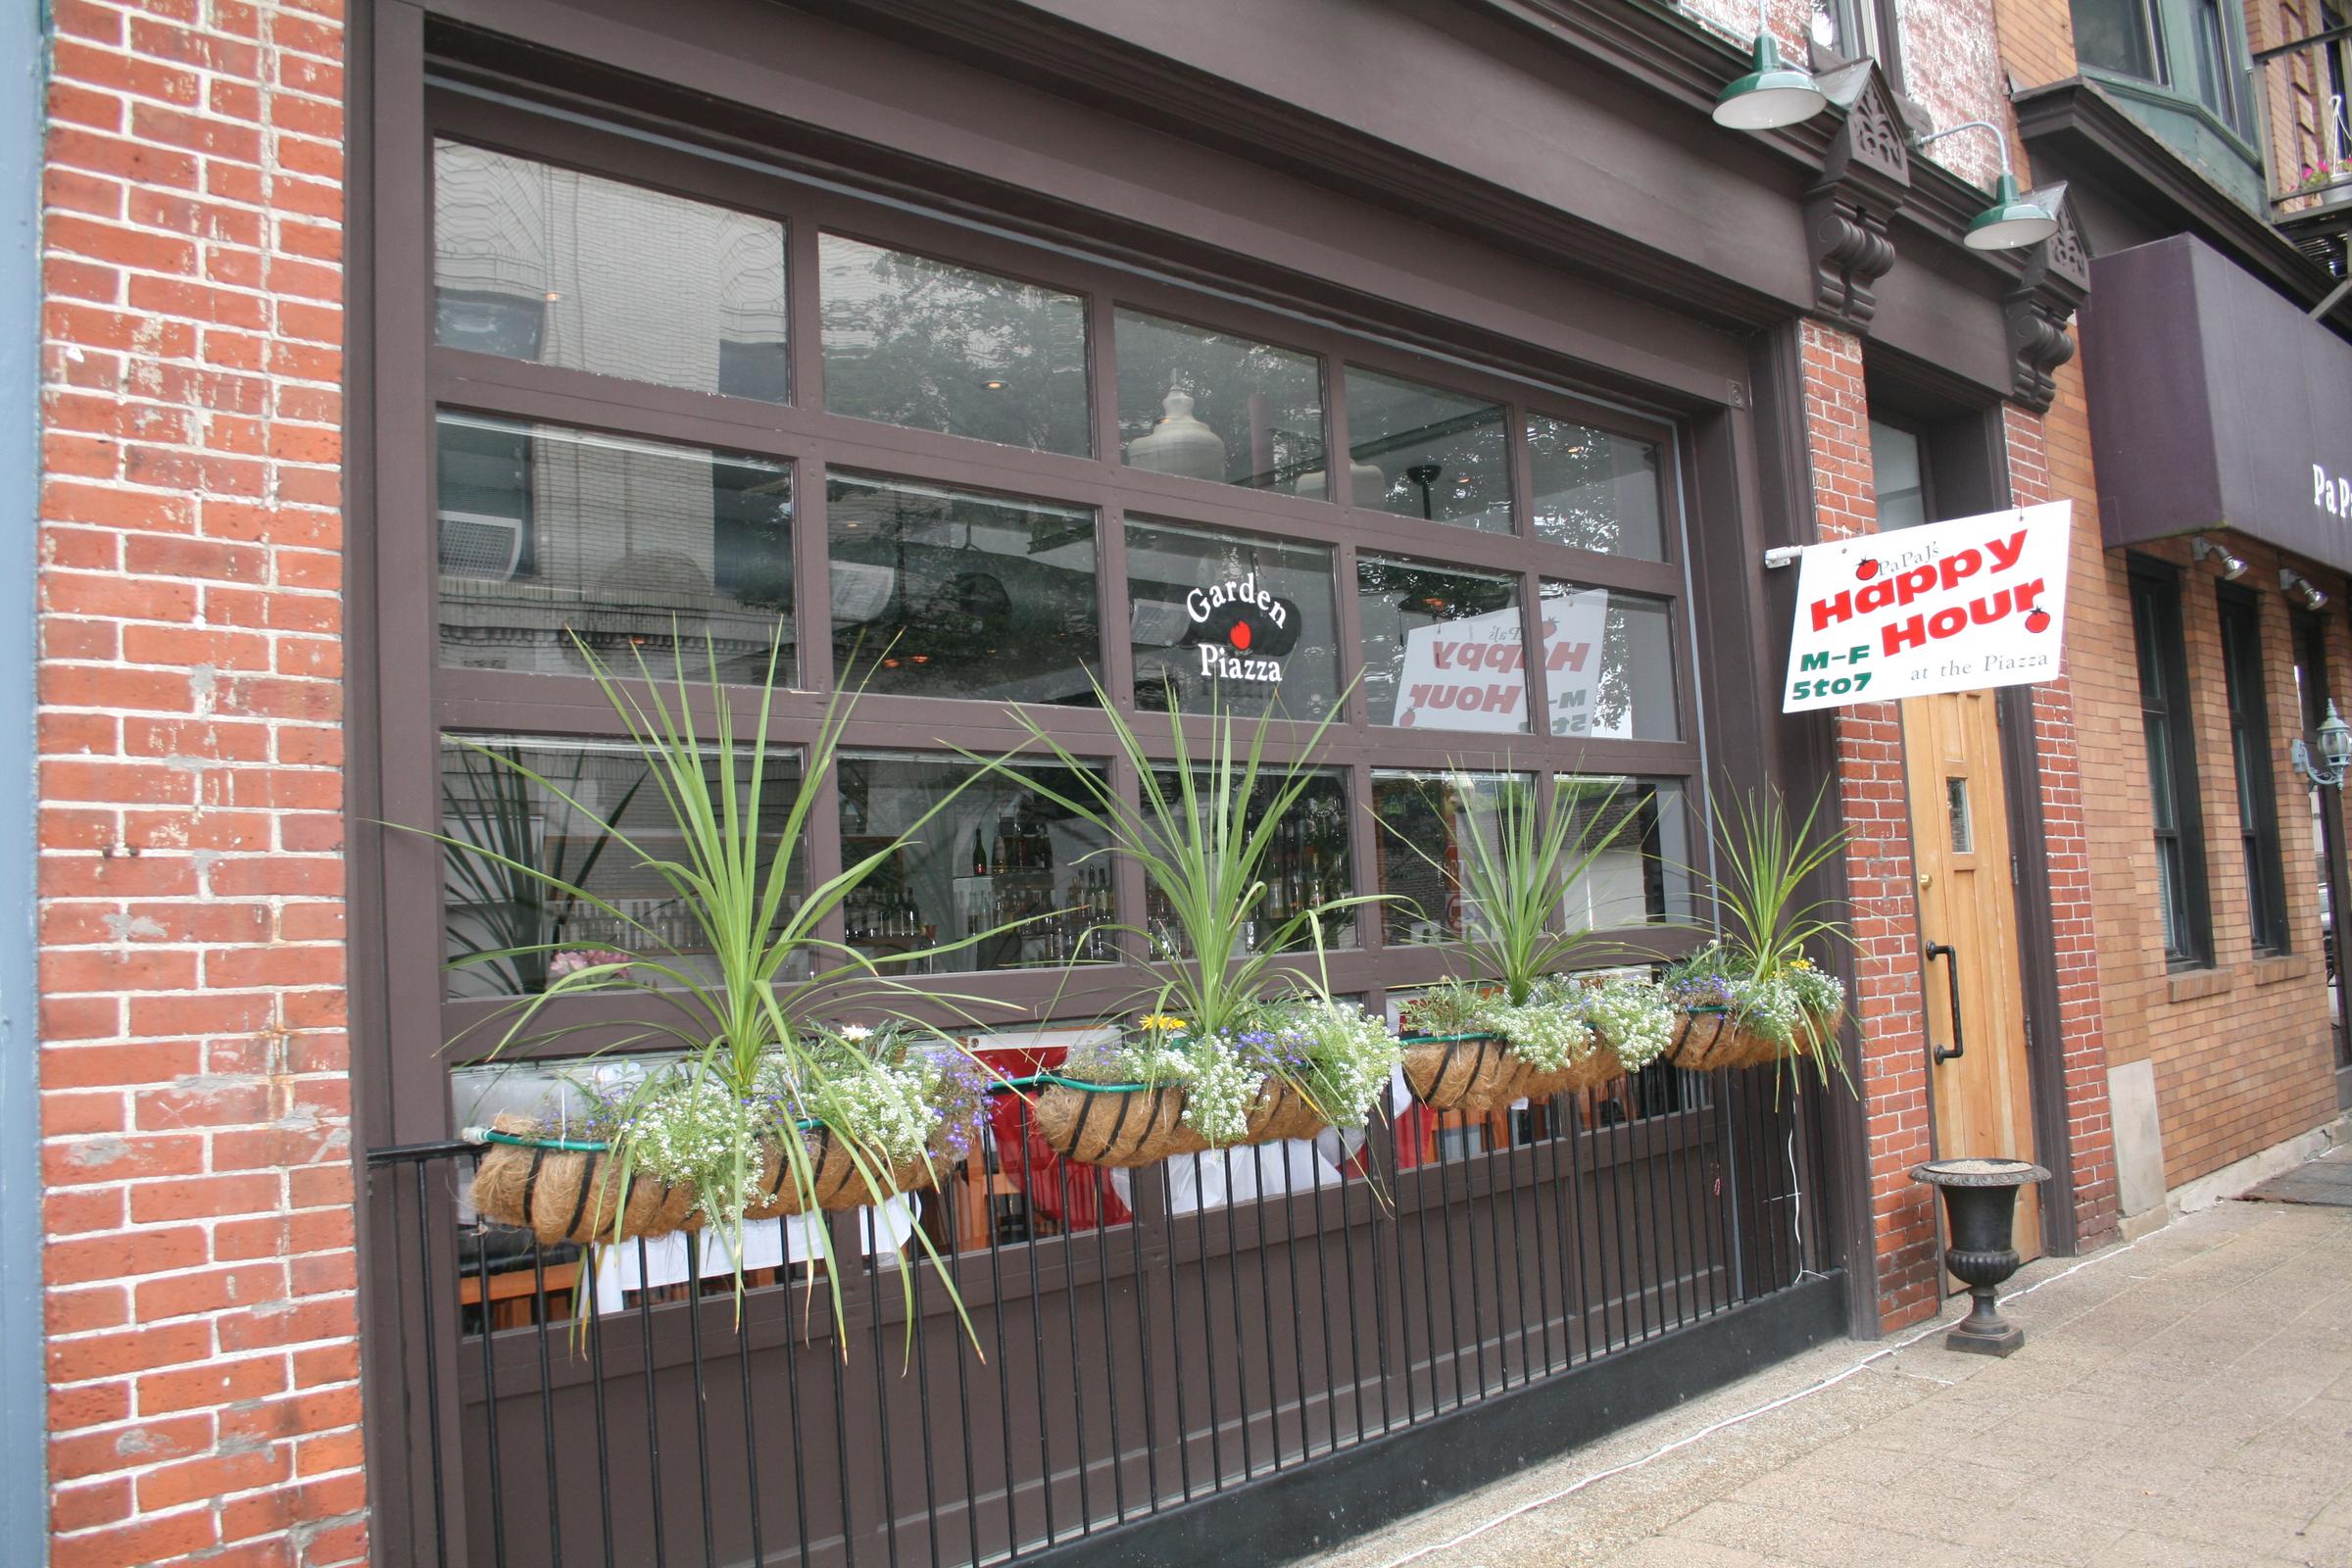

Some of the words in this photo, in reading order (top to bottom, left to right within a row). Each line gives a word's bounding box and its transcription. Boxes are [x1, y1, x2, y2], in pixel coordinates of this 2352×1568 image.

[2312, 463, 2352, 518] PaP
[1187, 572, 1287, 629] Garden
[1810, 528, 2028, 632] Happy
[1881, 577, 2045, 658] Hour
[1198, 643, 1283, 682] Piazza
[1800, 645, 1870, 672] M-F
[1910, 666, 1930, 681] at
[1940, 659, 1973, 677] the
[1984, 654, 2049, 672] Piazza
[1791, 671, 1872, 701] 5to7
